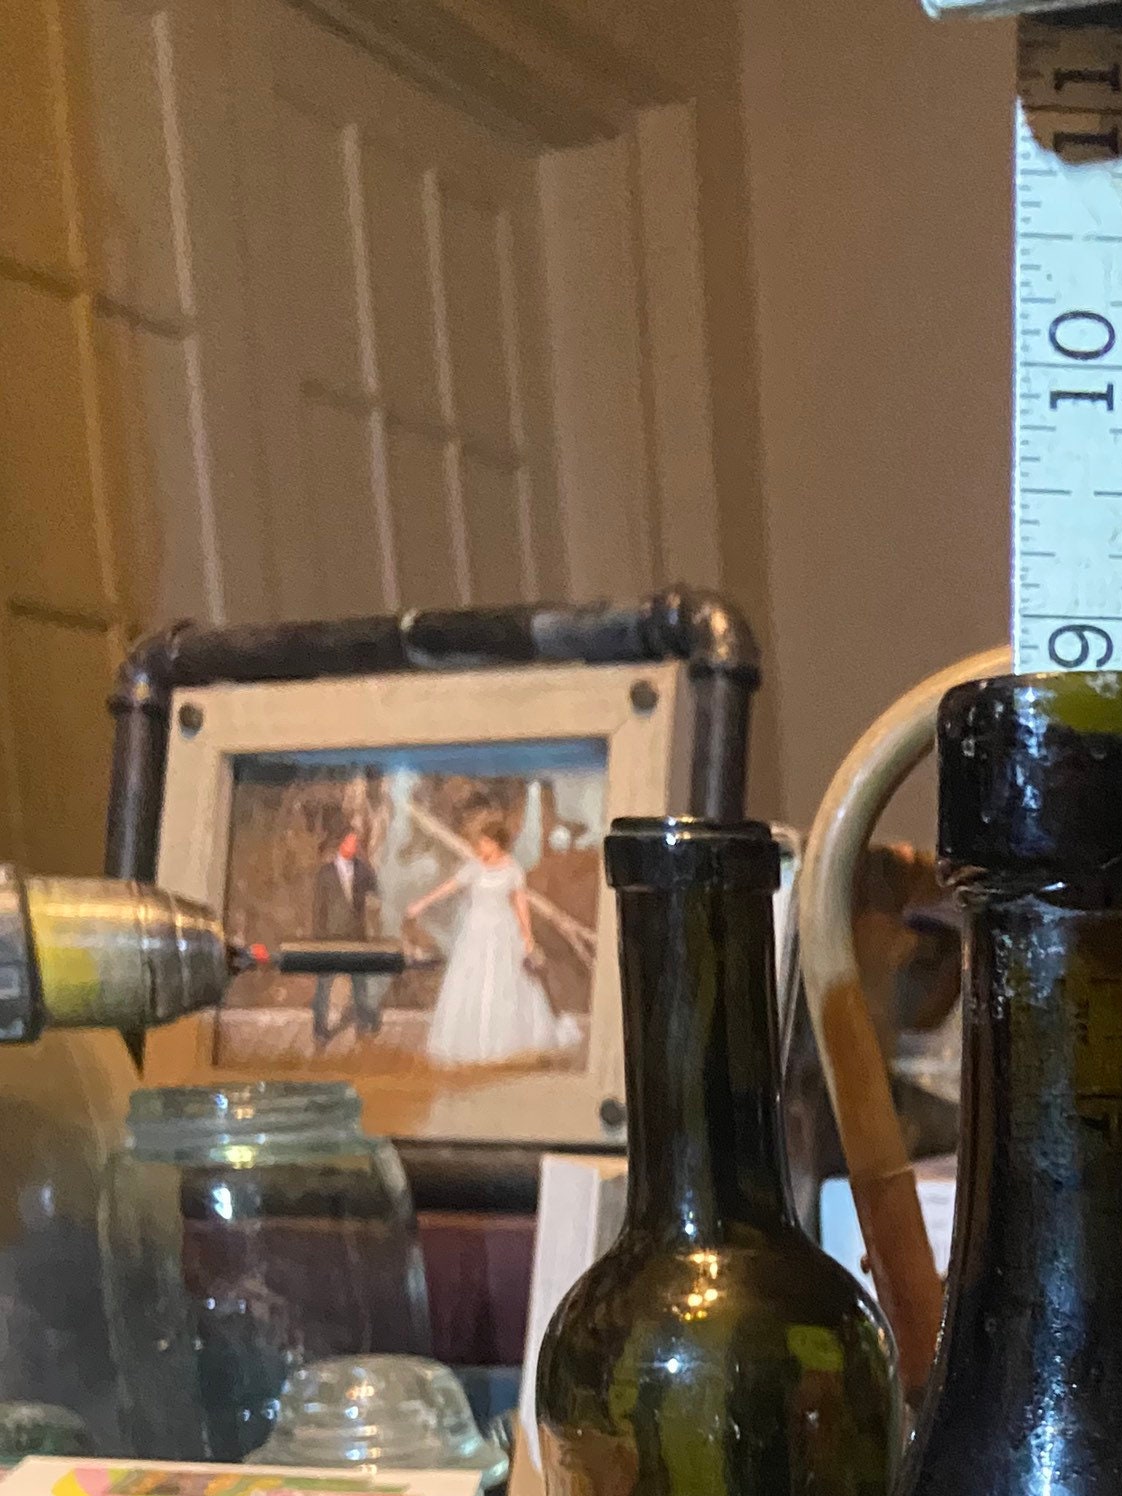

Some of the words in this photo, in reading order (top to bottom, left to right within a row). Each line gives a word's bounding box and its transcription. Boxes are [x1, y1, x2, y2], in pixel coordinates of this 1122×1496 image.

[1053, 62, 1120, 155] 11
[1049, 309, 1115, 412] 10
[1048, 623, 1114, 669] 9
